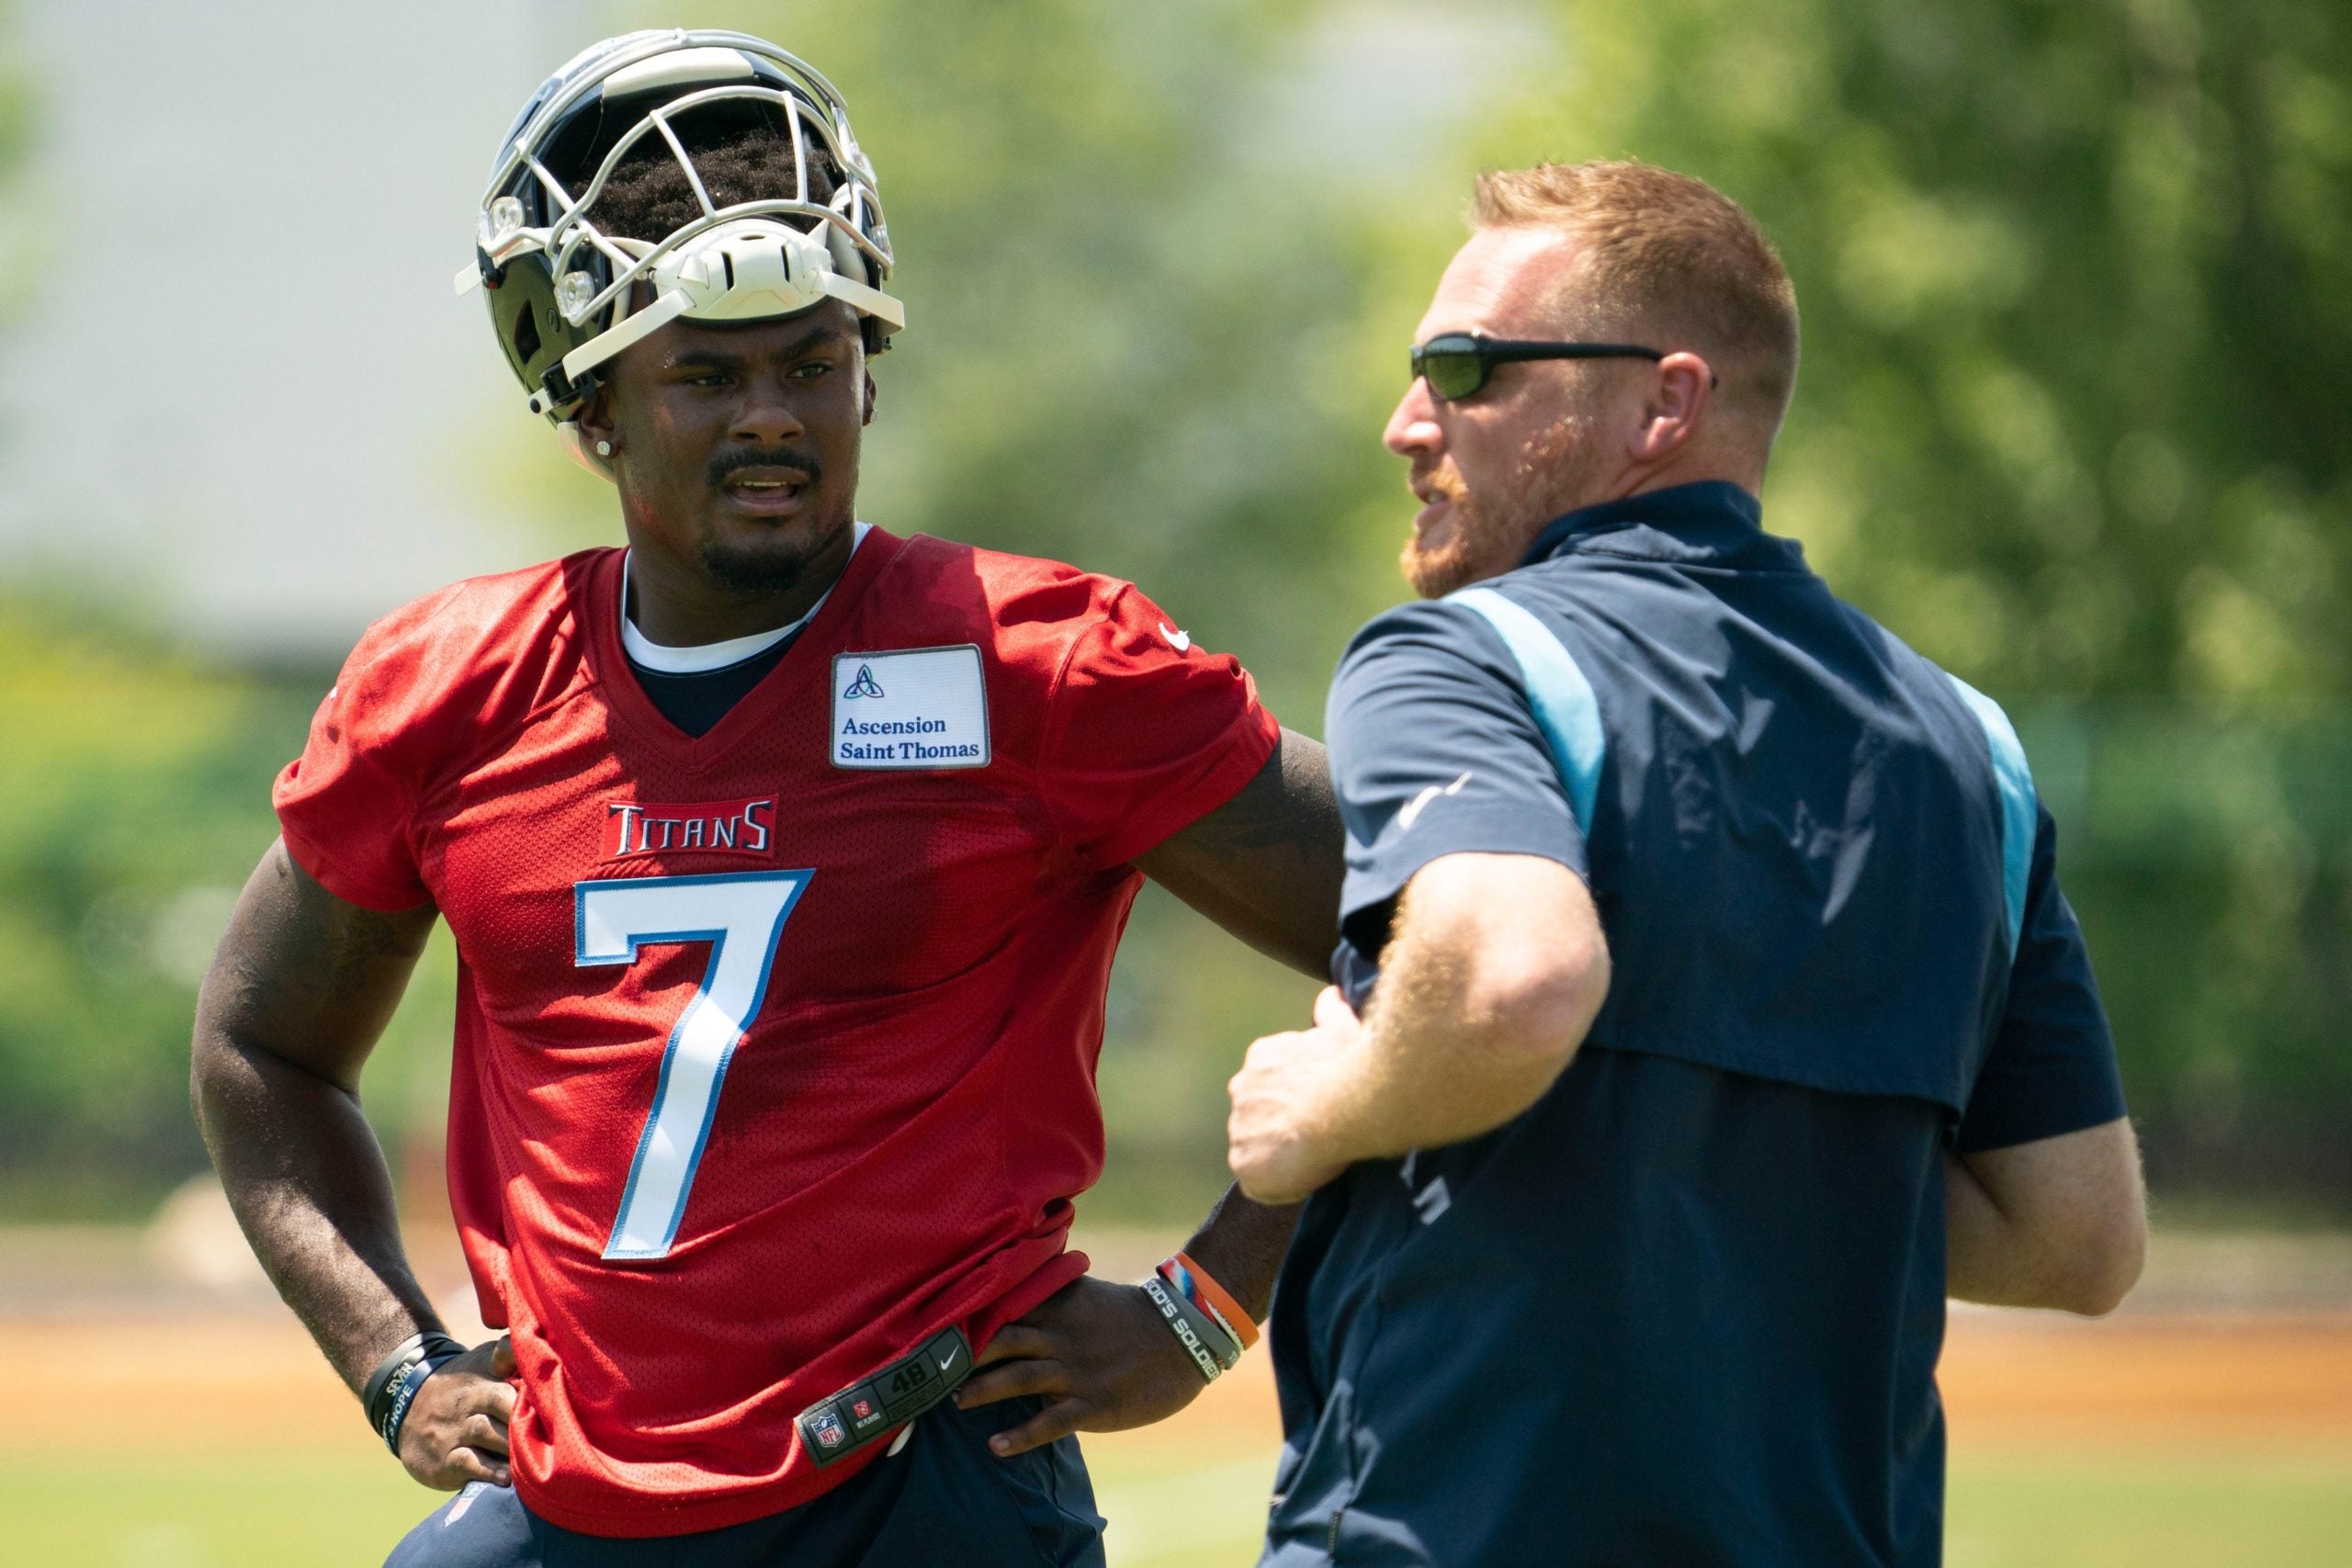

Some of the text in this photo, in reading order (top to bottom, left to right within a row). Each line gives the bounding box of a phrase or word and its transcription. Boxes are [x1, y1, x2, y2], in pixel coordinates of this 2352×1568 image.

[842, 716, 946, 735] Ascension
[840, 740, 979, 760] Saint Thomas
[608, 800, 772, 856] TITANS
[575, 868, 817, 1260] 7
[891, 1362, 927, 1393] 48
[390, 1384, 413, 1426] HOPE
[819, 1424, 842, 1445] NFL
